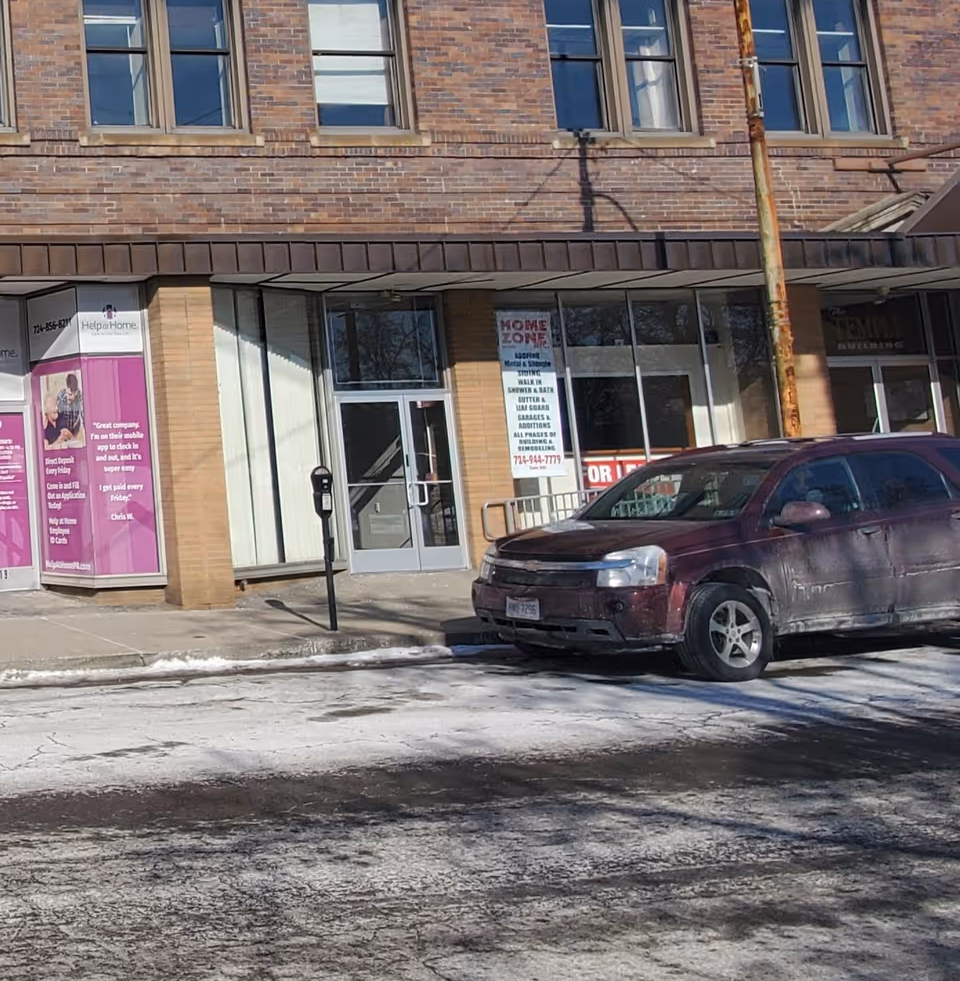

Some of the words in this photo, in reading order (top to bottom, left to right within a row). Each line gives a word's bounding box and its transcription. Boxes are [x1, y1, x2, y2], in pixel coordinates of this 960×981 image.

[501, 320, 547, 331] HOME
[502, 332, 546, 344] ZONE
[837, 340, 904, 351] BUILDING
